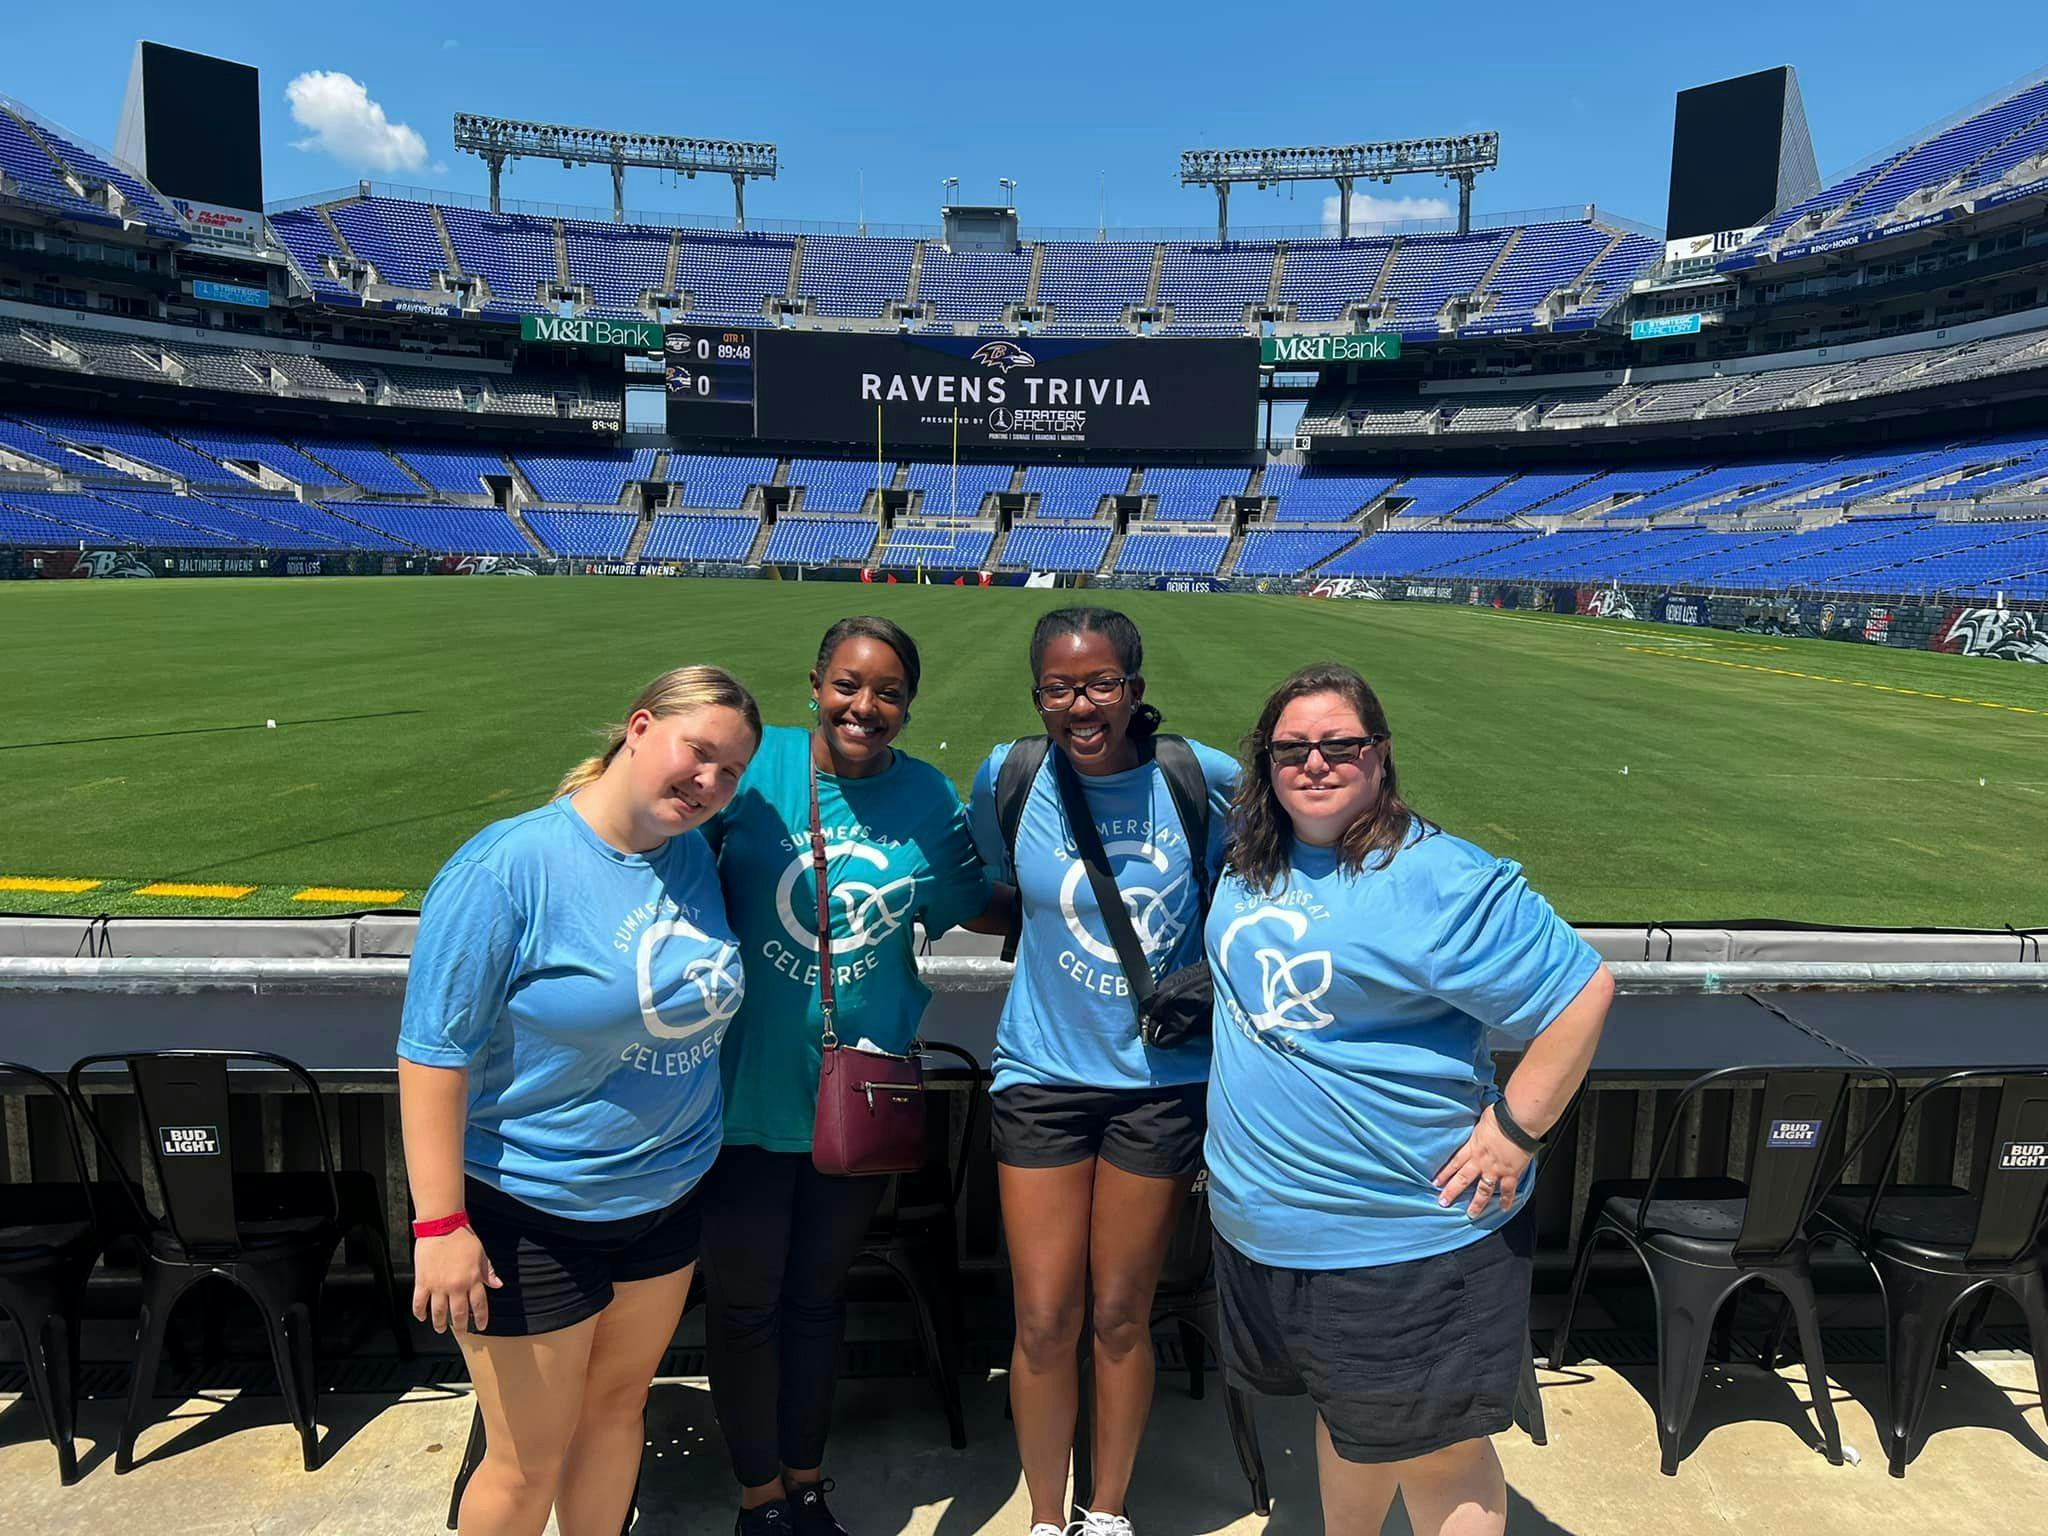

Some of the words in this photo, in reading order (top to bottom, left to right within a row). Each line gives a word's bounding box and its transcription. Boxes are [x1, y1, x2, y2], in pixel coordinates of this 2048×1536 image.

[395, 303, 449, 316] #RAVENSFLOCK
[534, 316, 595, 342] M&T
[596, 321, 652, 345] Bank
[697, 338, 710, 359] 0
[718, 344, 751, 359] 89:48
[1274, 337, 1331, 361] M&T
[1332, 336, 1387, 359] Bank
[697, 375, 710, 396] 0
[861, 373, 1006, 404] RAVENS
[1024, 378, 1152, 405] TRIVIA
[920, 416, 969, 424] PRESENED
[1014, 409, 1086, 421] STRATEGIC
[591, 420, 620, 431] 89:48
[1014, 420, 1086, 432] FACTORY
[179, 559, 222, 572] BALTIMORE
[224, 559, 254, 572] RAVENS
[586, 563, 637, 576] BALTIMORE
[639, 564, 676, 576] RAVENS
[876, 834, 902, 850] AT
[1054, 819, 1153, 862] SUMERS
[1156, 827, 1182, 848] AT
[681, 903, 701, 921] AT
[1307, 904, 1331, 920] AT
[620, 1025, 724, 1077] CELEBREE
[1779, 1123, 1811, 1132] BUD
[169, 1129, 208, 1141] BUD
[1772, 1131, 1815, 1139] LIGHT
[164, 1140, 216, 1153] LIGHT
[2010, 1145, 2045, 1156] BUD
[2001, 1155, 2048, 1167] LIGHT
